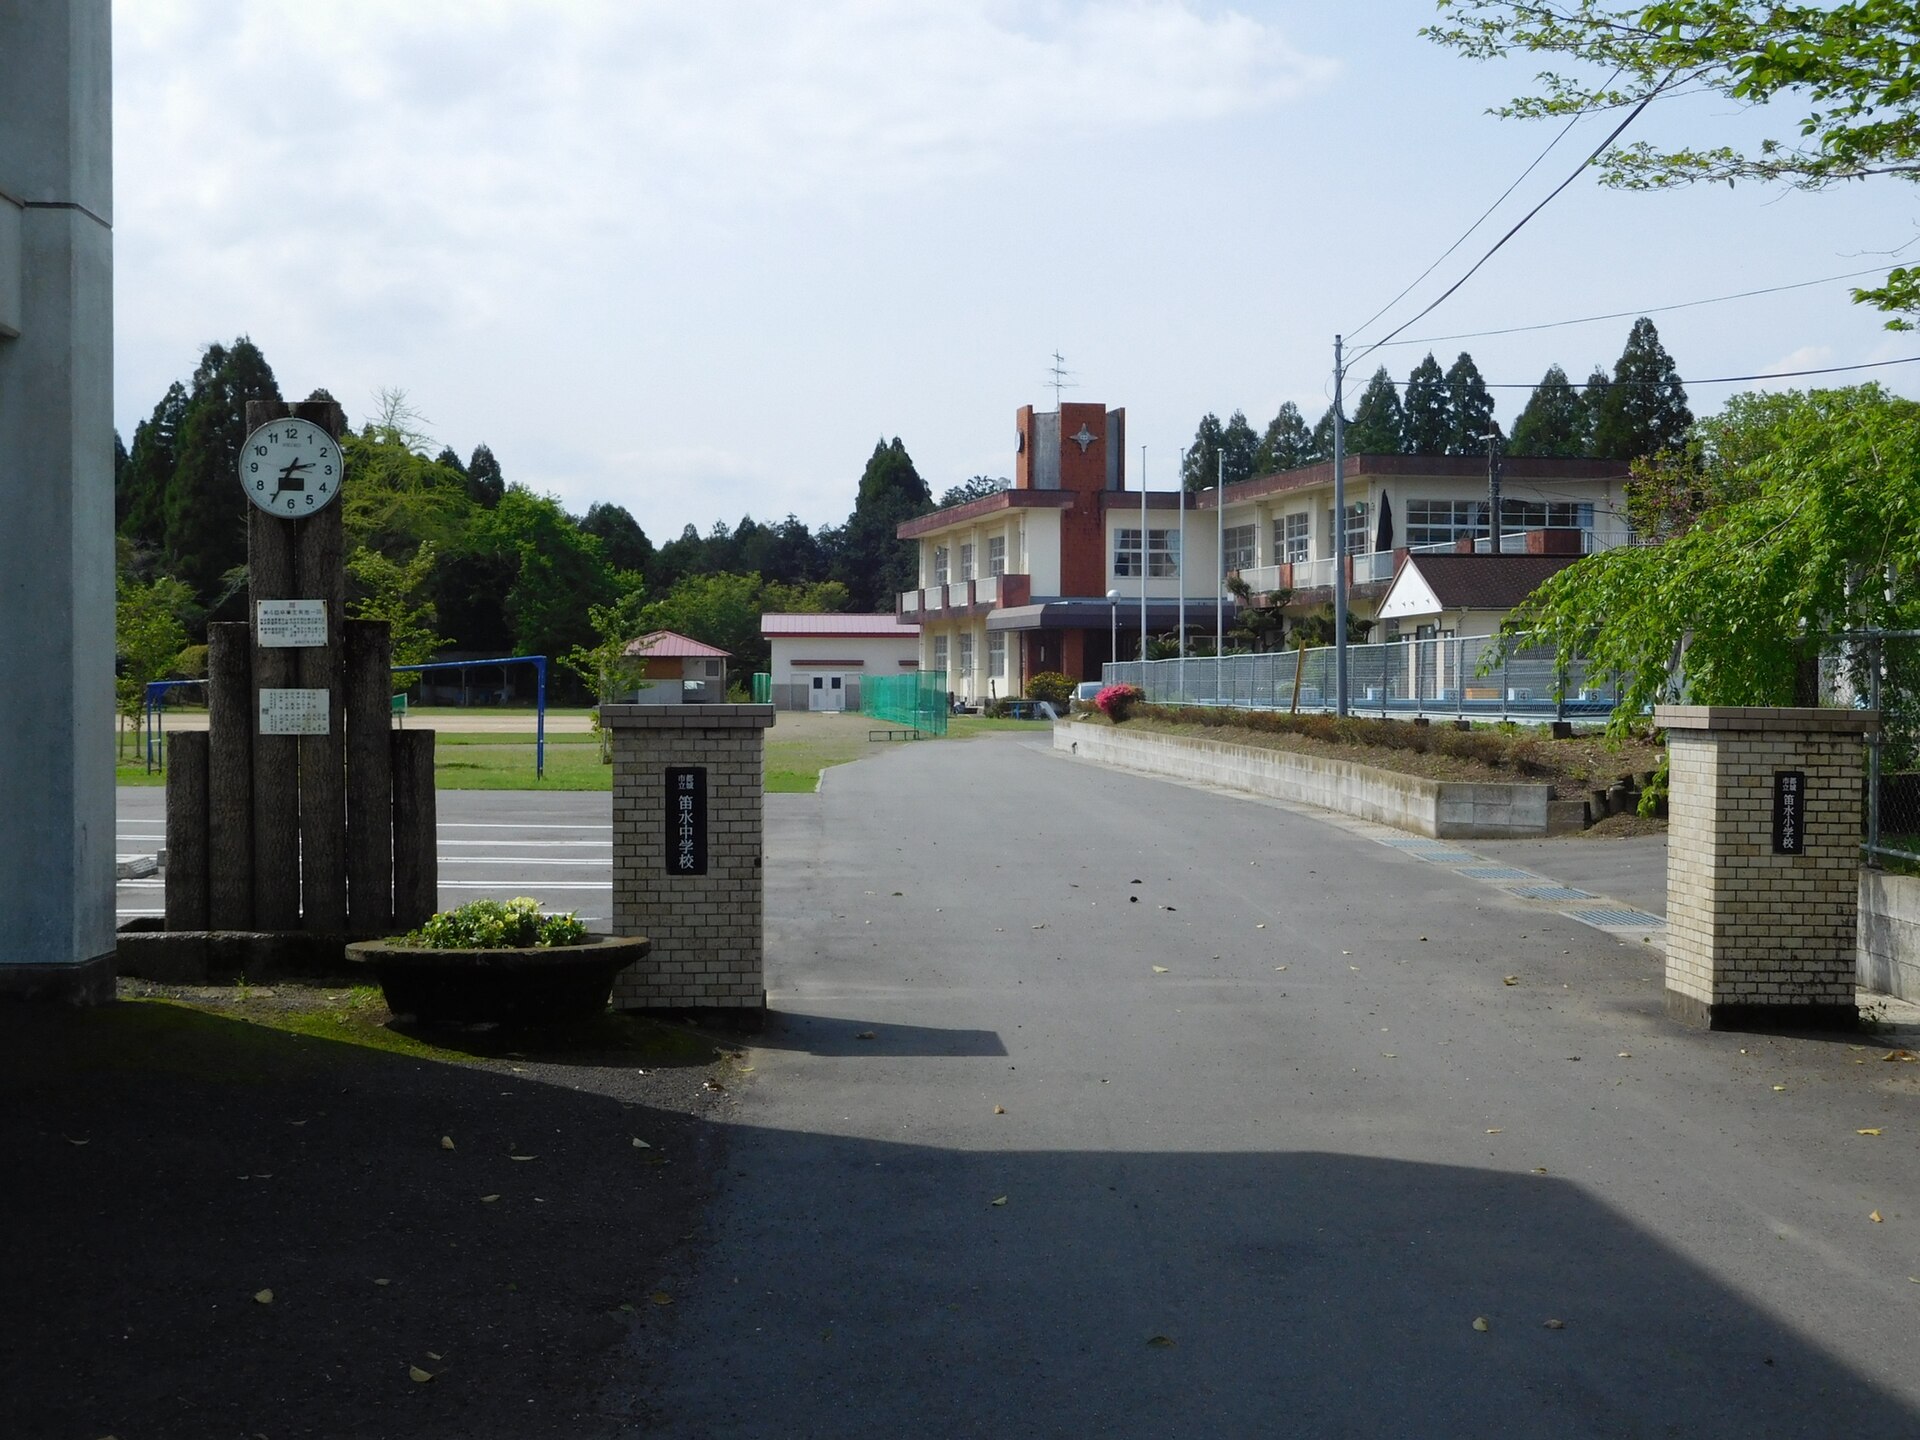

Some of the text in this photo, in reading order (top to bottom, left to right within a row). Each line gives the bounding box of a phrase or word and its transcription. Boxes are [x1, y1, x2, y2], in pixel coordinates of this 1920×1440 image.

[268, 433, 278, 444] 11
[285, 428, 298, 439] 12
[307, 434, 313, 445] 1
[254, 445, 268, 456] 10
[319, 447, 328, 458] 2
[250, 462, 259, 473] 9
[324, 465, 333, 475] 3
[256, 480, 265, 491] 8
[319, 482, 327, 493] 4
[287, 498, 295, 509] 6
[305, 494, 314, 505] 5
[1591, 691, 1598, 700] 5
[1782, 794, 1795, 849] 笛水小学校
[678, 795, 695, 870] 笛水中学校
